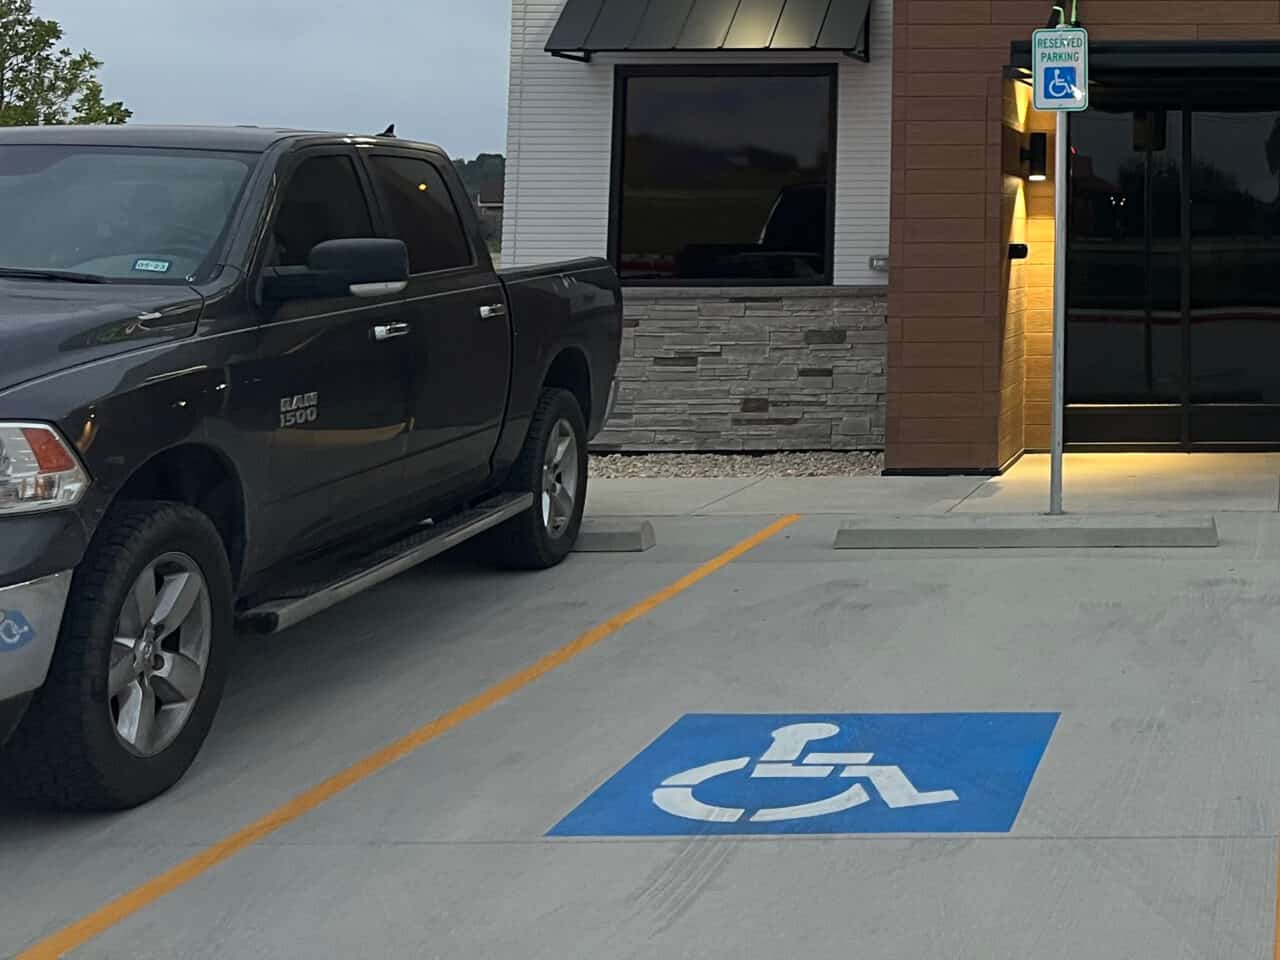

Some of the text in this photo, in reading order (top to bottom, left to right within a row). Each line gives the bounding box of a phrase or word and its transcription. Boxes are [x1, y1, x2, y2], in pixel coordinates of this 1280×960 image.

[1037, 38, 1083, 49] RESERVED
[1041, 52, 1079, 62] PARKING
[280, 392, 318, 413] RAM
[280, 407, 318, 427] 1500
